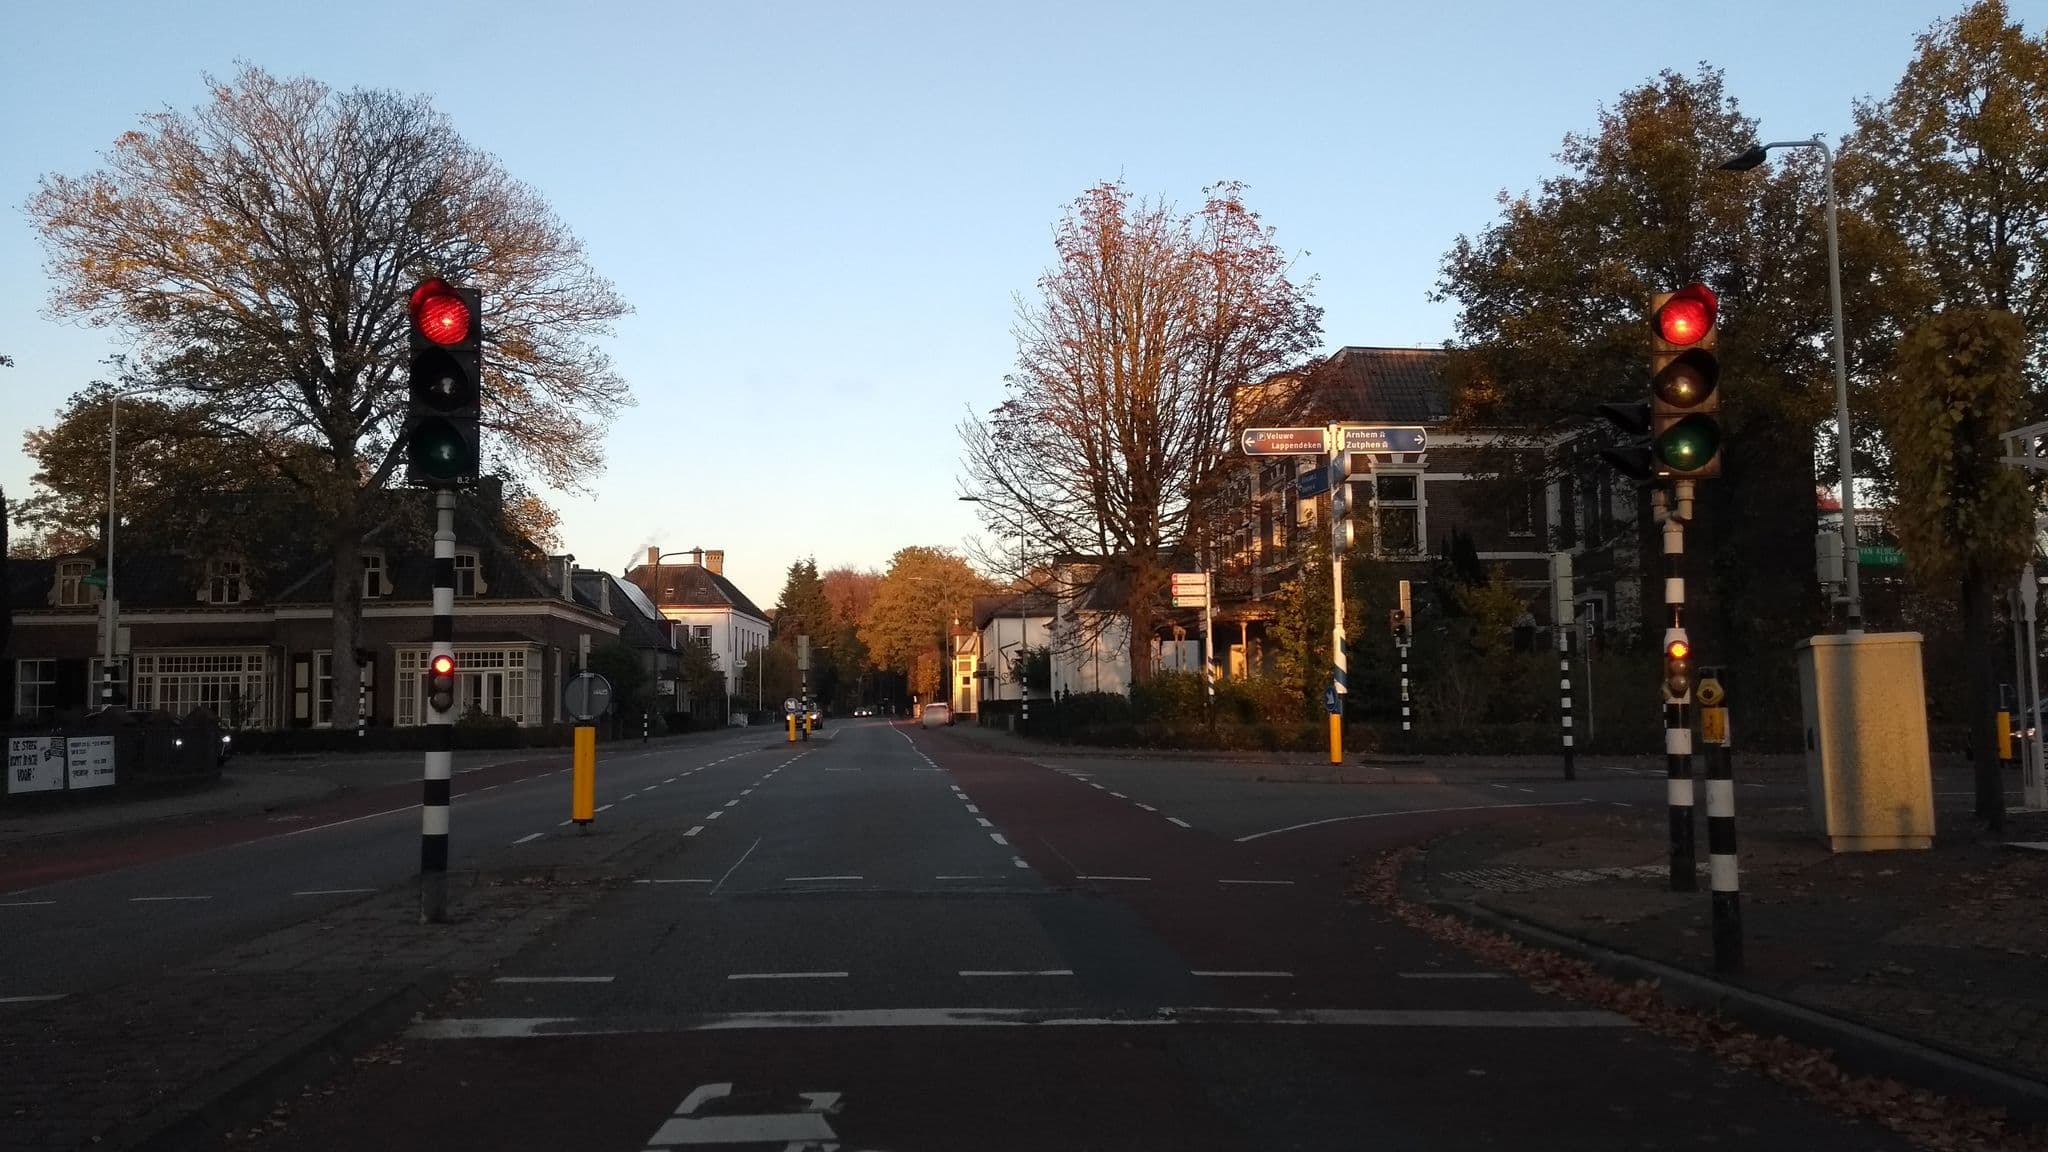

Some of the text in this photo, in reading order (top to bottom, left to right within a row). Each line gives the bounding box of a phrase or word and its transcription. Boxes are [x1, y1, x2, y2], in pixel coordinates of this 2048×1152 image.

[1266, 432, 1294, 440] Veluwe
[1346, 431, 1378, 439] Arnhem
[1271, 442, 1322, 450] Lappendeken
[1346, 441, 1381, 450] Zutphen
